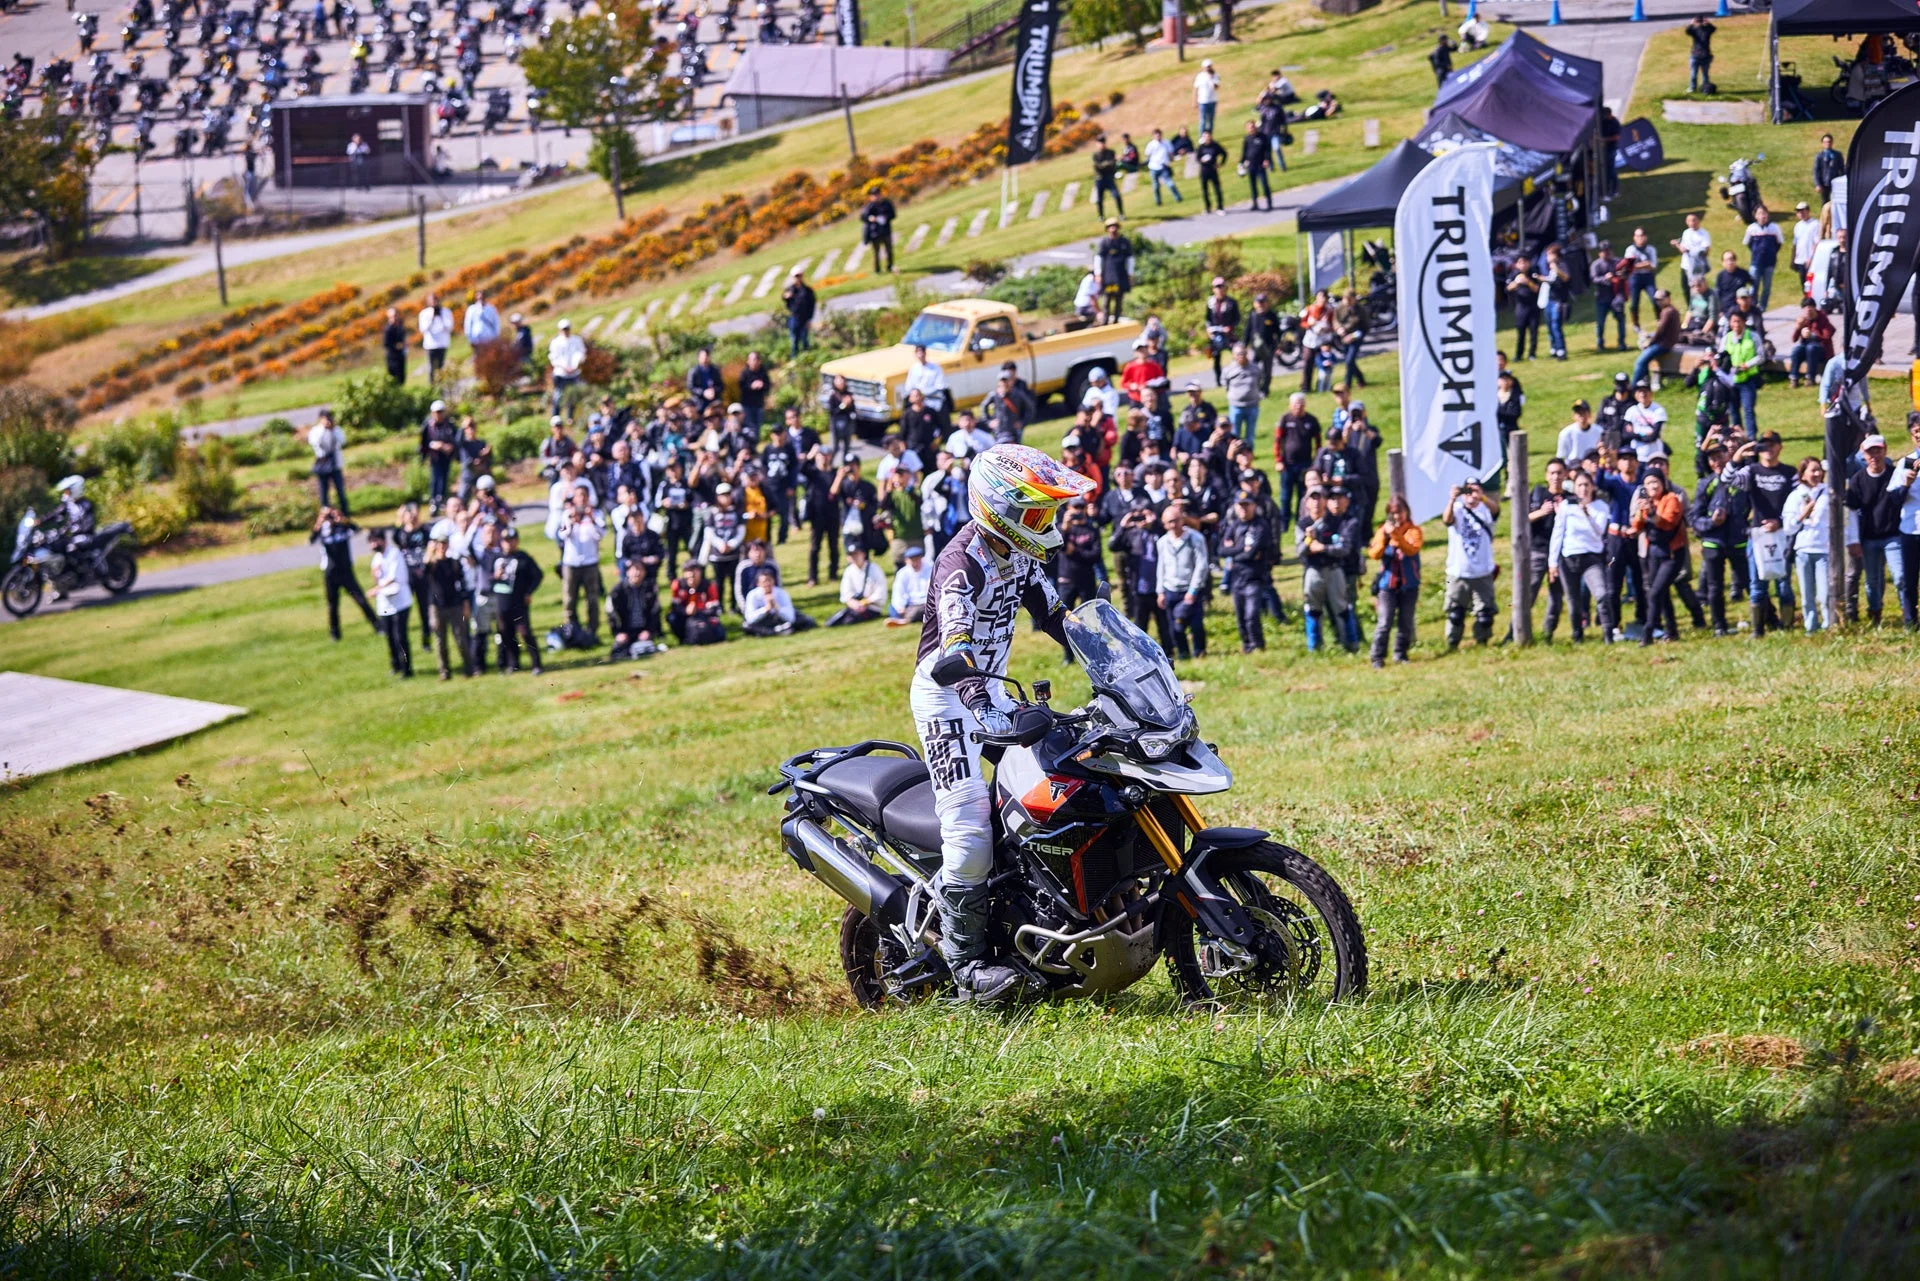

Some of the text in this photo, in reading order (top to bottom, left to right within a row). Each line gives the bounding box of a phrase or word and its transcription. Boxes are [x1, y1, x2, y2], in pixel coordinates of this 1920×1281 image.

[1020, 24, 1050, 126] TRIUMPH
[1432, 186, 1475, 411] TRIUMPH
[1027, 841, 1074, 856] TIGER
